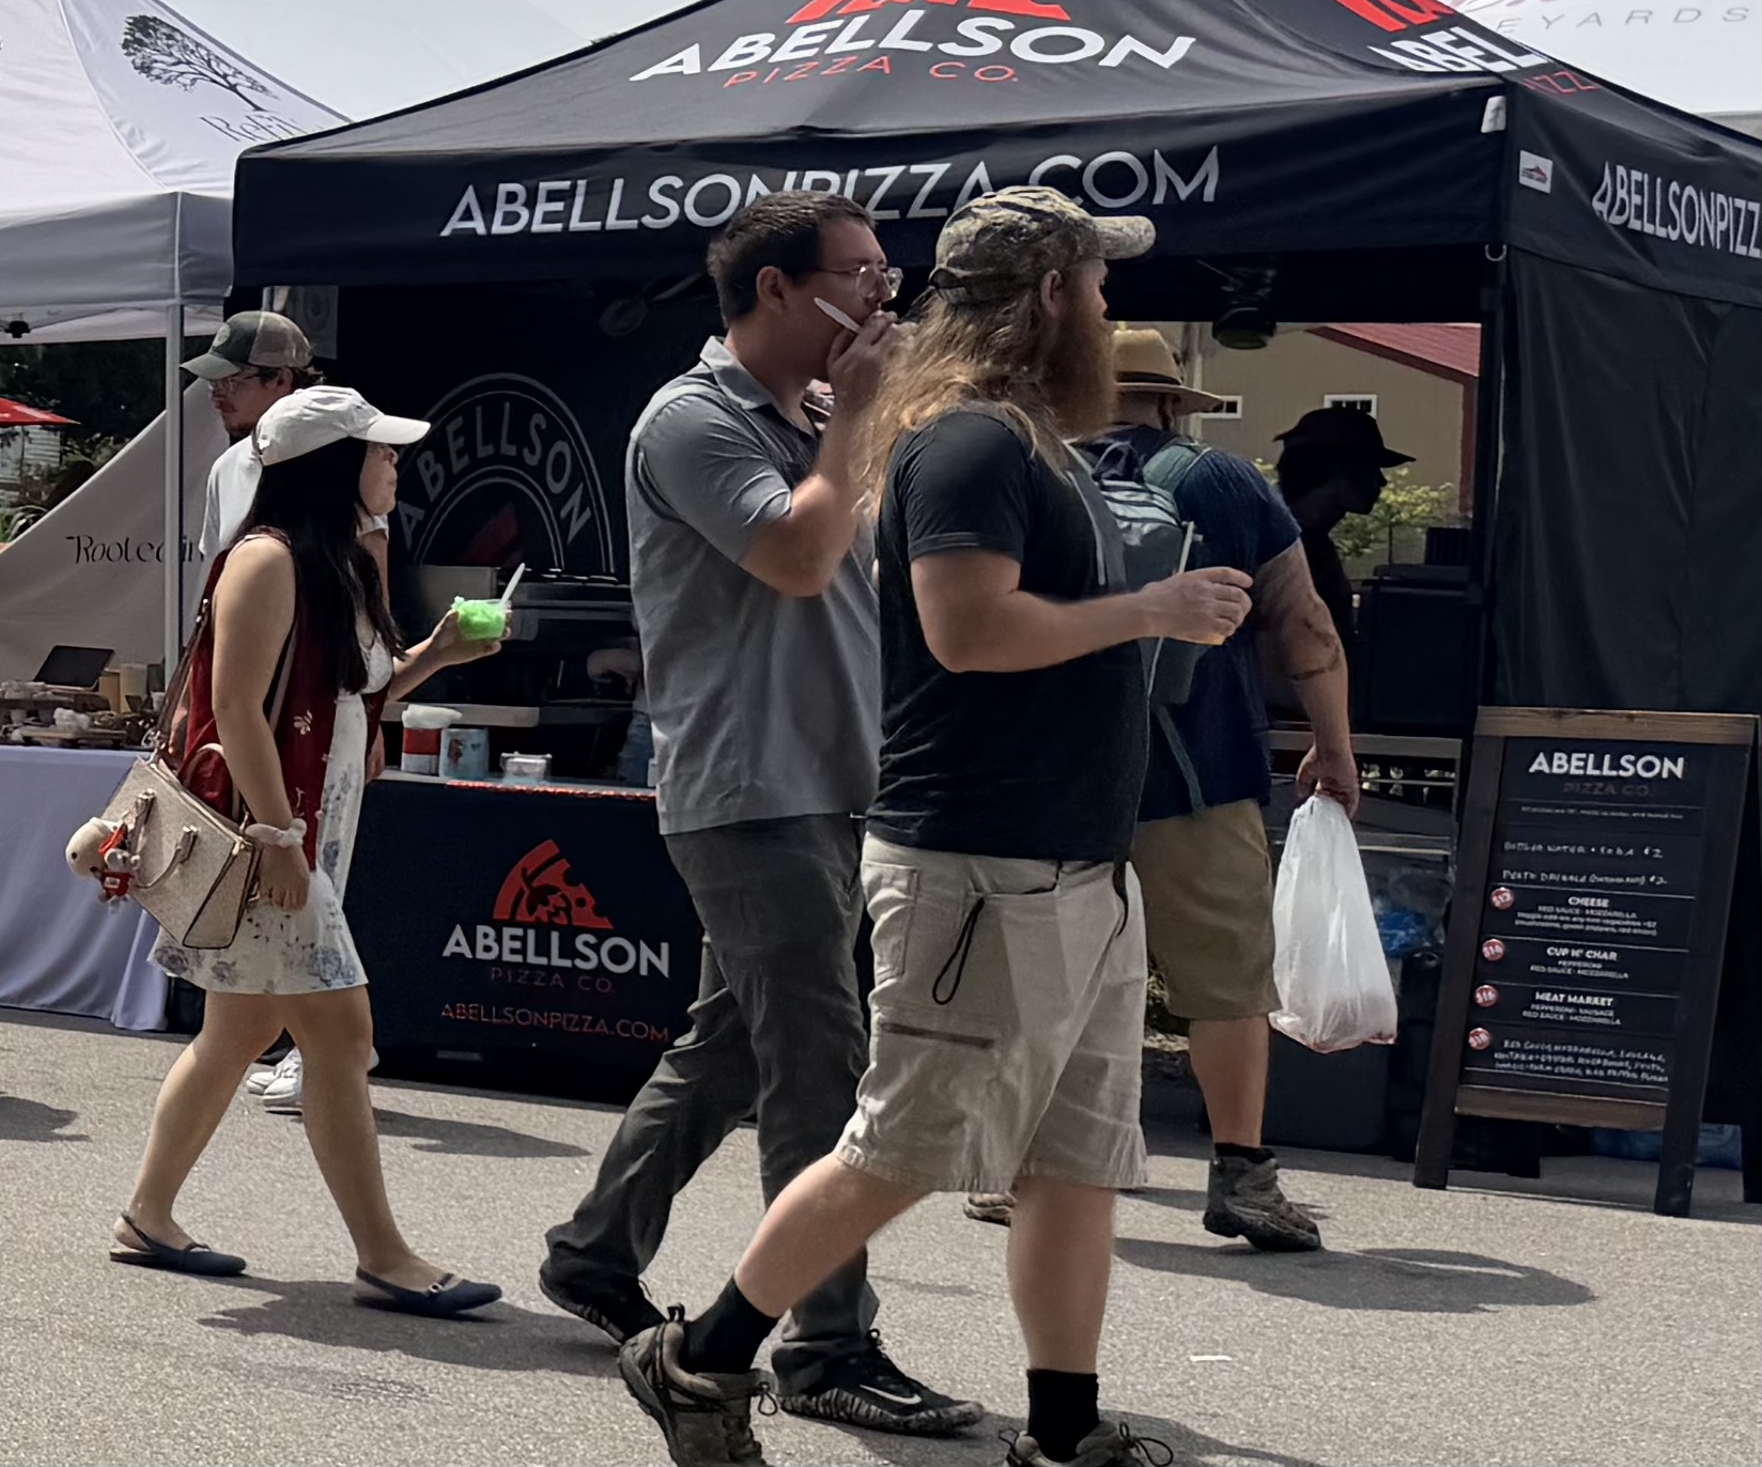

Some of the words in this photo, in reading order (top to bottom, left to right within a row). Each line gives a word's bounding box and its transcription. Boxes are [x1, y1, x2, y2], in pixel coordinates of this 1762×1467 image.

[629, 9, 1196, 82] ABELLSON
[1367, 27, 1555, 72] ABEL
[723, 55, 892, 88] PIZZA
[930, 61, 1019, 83] CO.
[439, 144, 1219, 237] ABELLSONPIZZACOM
[398, 402, 592, 552] ABELLSON
[1529, 751, 1685, 780] ABELLSON
[1563, 781, 1615, 796] PIZZA
[1568, 896, 1609, 908] CHEESE
[442, 924, 669, 978] ABELLSON
[1547, 946, 1569, 957] CUP
[1585, 949, 1617, 961] CHAR
[491, 966, 565, 988] PIZZA
[1535, 991, 1565, 1003] MEAT
[1567, 995, 1613, 1007] MARKET
[441, 1003, 670, 1042] ABELLSONPIZZA.COM
